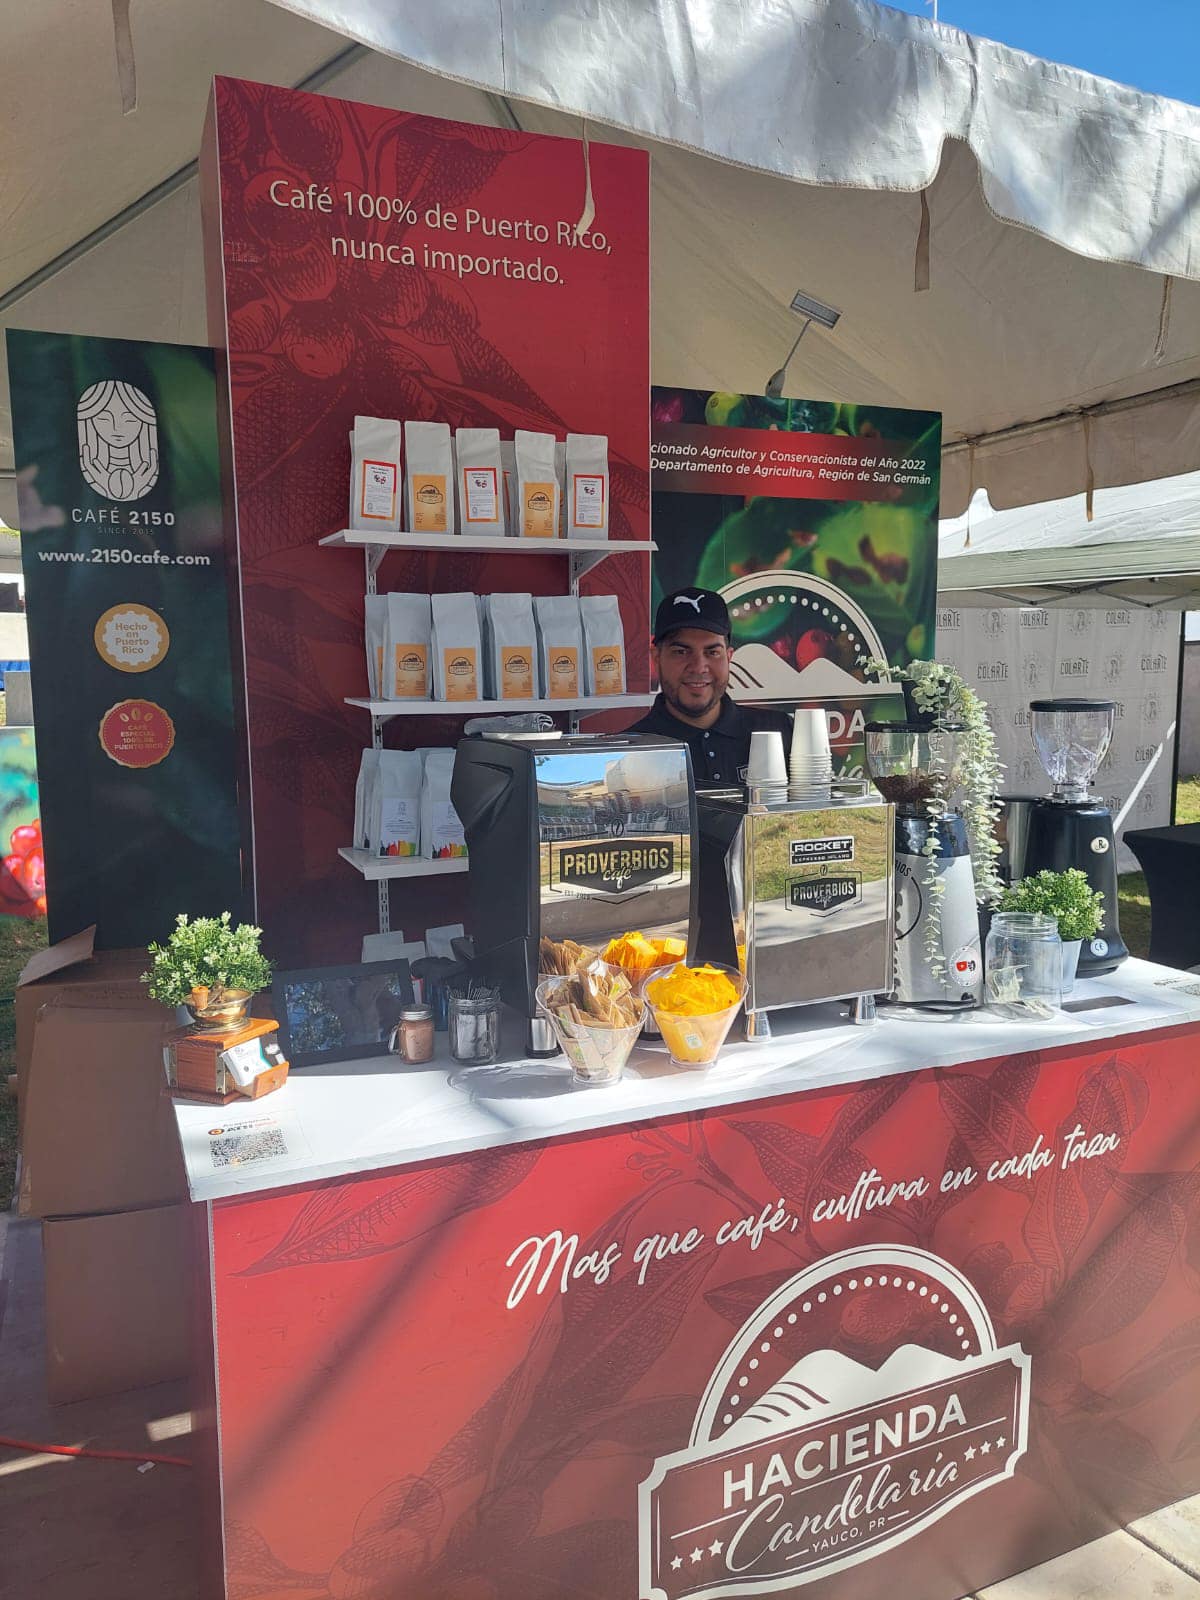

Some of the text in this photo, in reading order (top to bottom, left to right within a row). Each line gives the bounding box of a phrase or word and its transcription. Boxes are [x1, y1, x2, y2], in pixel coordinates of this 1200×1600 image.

[270, 180, 612, 255] Café 100% de Puerto Rico,
[331, 236, 564, 284] nunca importado.
[650, 442, 698, 456] cionado
[759, 453, 767, 462] y
[769, 450, 858, 466] Conservacionista
[860, 456, 877, 467] del
[878, 457, 899, 469] Año
[900, 459, 927, 471] 2022
[650, 457, 931, 485] Departamento de Agricultura, Región de San Germán
[71, 506, 176, 526] CAFÉ 2150
[38, 548, 211, 566] www.2150cafe.com
[115, 622, 148, 631] Hecho
[936, 609, 961, 627] OLARTE
[115, 638, 149, 646] Puerto
[122, 646, 144, 654] Rico
[794, 840, 850, 853] ROCKET
[564, 847, 669, 877] PROVERBIOS
[793, 881, 854, 901] PROVERBIOS
[506, 1123, 1121, 1309] Mas que café, cultura en cada taza
[723, 1393, 968, 1510] HACIENDA
[812, 1516, 886, 1553] YAUCO, PR
